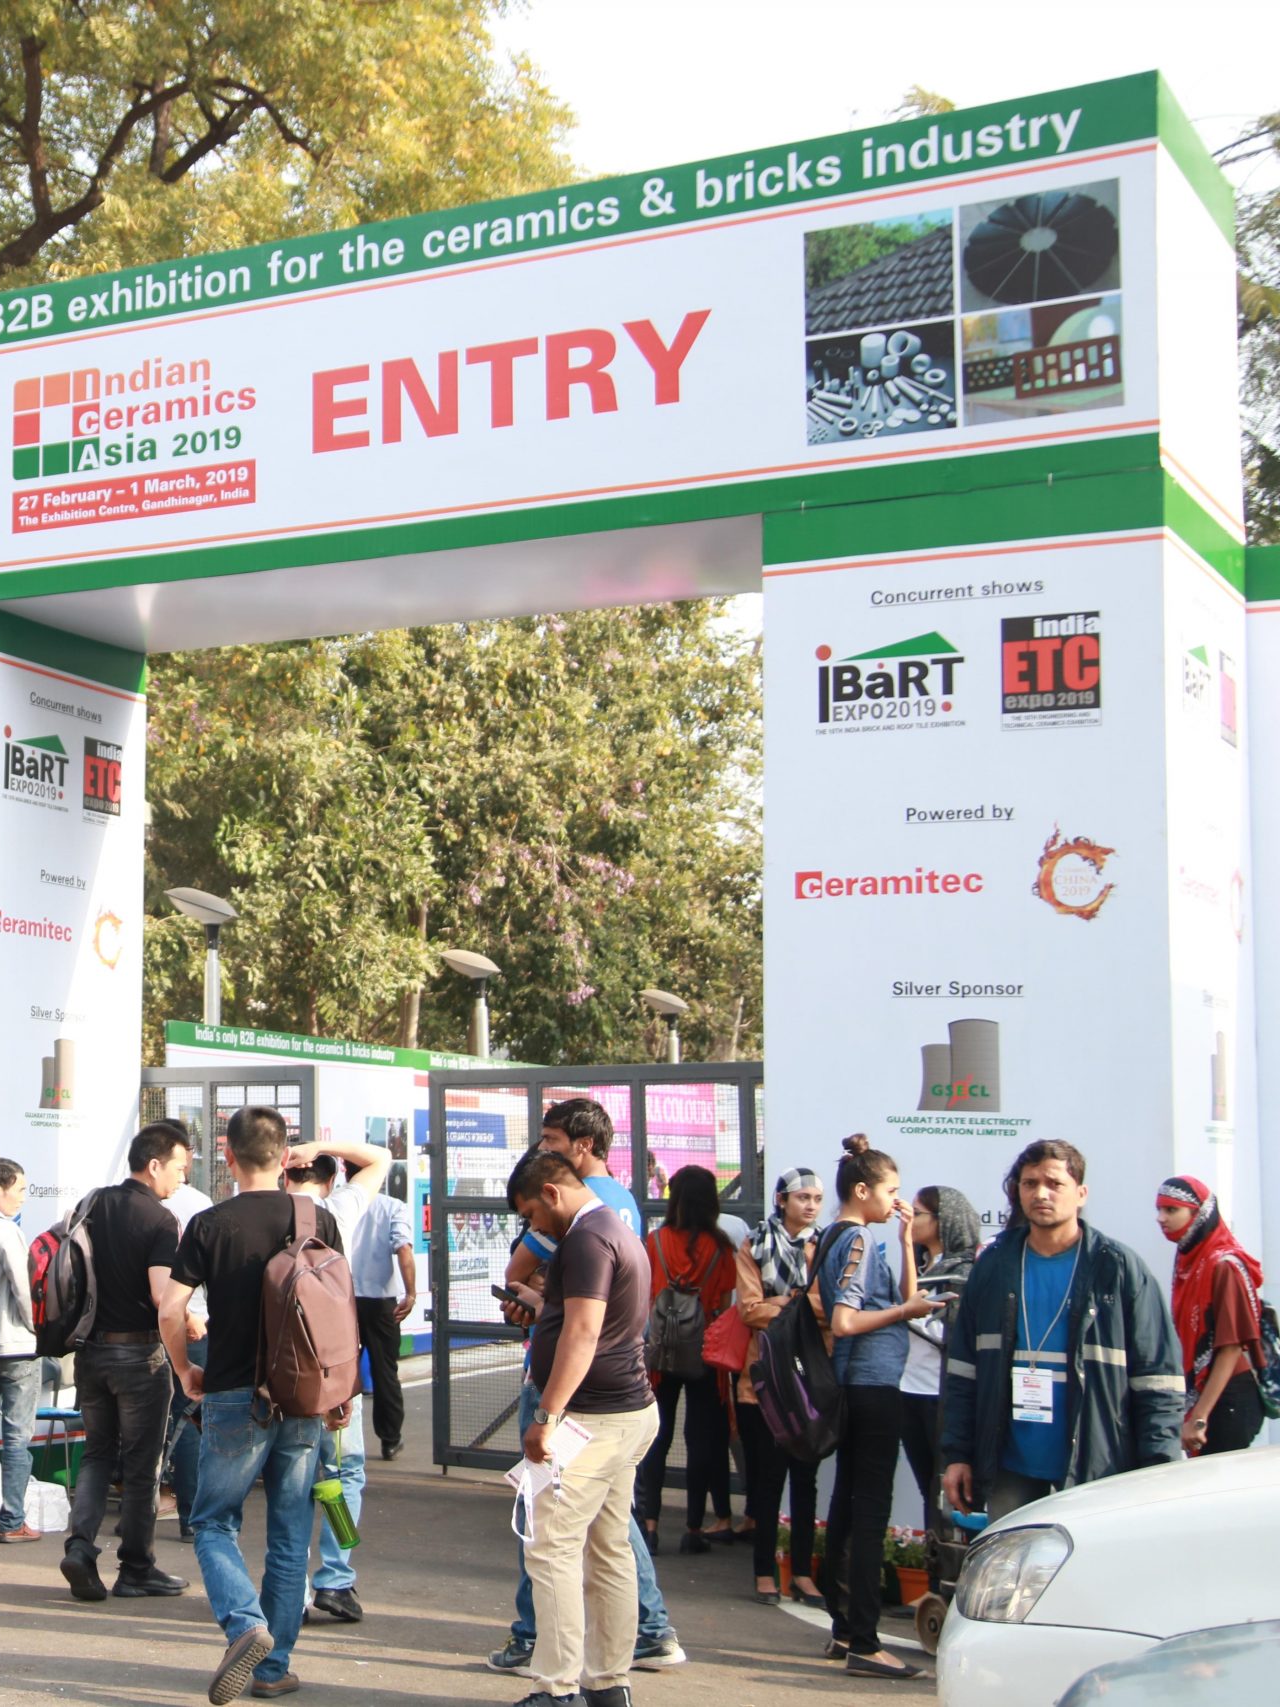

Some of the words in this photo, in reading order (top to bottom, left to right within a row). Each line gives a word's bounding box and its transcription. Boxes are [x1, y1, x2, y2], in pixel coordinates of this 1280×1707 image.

[67, 263, 251, 322] exhibition
[267, 250, 324, 287] for
[338, 234, 405, 274] the
[422, 195, 620, 258] ceramics
[639, 177, 678, 218] &
[695, 151, 842, 210] bricks
[862, 107, 1083, 180] industry
[85, 356, 211, 400] Indian
[311, 308, 713, 454] ENTRY
[77, 432, 157, 471] Asia
[172, 425, 242, 458] 2019
[18, 495, 38, 511] 27
[43, 486, 112, 507] February
[130, 481, 139, 496] 1
[144, 473, 201, 494] March,
[206, 466, 249, 487] 2019
[19, 514, 38, 527] The
[41, 507, 96, 524] Exhibition
[99, 502, 139, 516] Centre,
[143, 491, 217, 511] Gandhinagar,
[221, 487, 250, 501] India
[871, 583, 974, 605] Concurrent
[981, 579, 1044, 596] shows
[1033, 614, 1100, 638] india
[1003, 635, 1100, 694] ETC
[30, 691, 74, 715] Concurrent
[77, 706, 102, 722] shows
[1004, 693, 1056, 710] expo
[1057, 690, 1095, 706] 2019
[906, 805, 984, 822] Powered
[992, 804, 1014, 820] by
[40, 868, 75, 887] Powered
[77, 875, 86, 889] by
[892, 981, 941, 996] Silver
[949, 980, 1023, 998] Sponsor
[30, 1005, 52, 1019] Silver
[195, 1026, 221, 1042] India's
[222, 1029, 238, 1047] only
[240, 1031, 255, 1046] B2B
[257, 1032, 290, 1050] exhibition
[291, 1037, 302, 1052] for
[303, 1039, 314, 1053] the
[316, 1041, 344, 1056] ceramics
[352, 1044, 370, 1058] bricks
[887, 1115, 932, 1124] GUJARAT
[935, 1116, 967, 1125] STATE
[969, 1118, 1032, 1127] ELECTRICITY
[900, 1126, 974, 1136] CORPORATION
[976, 1128, 1017, 1137] LIMITED
